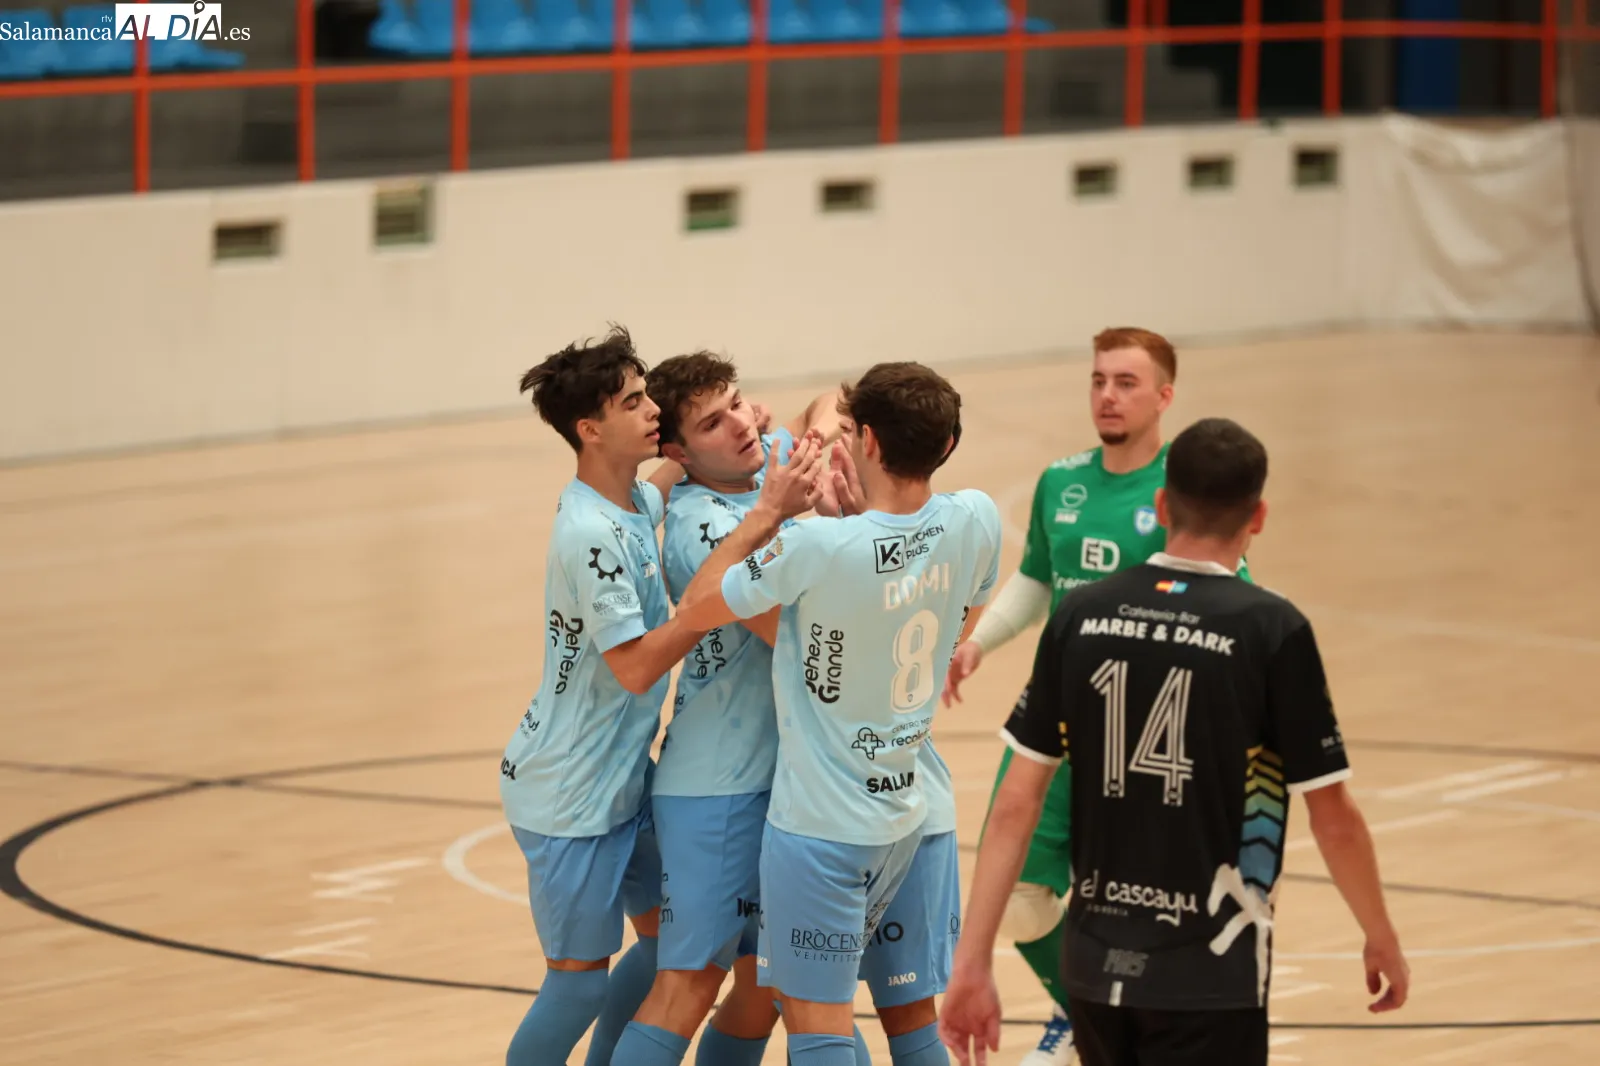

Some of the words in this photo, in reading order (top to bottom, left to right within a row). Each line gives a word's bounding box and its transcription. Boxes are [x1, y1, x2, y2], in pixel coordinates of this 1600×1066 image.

[884, 562, 950, 610] DOMI
[554, 617, 584, 695] Dehesa
[817, 630, 844, 704] Grande
[890, 609, 939, 714] 8
[1079, 617, 1149, 640] MARBE
[1152, 623, 1169, 642] &
[1172, 625, 1235, 656] DARK
[1089, 658, 1194, 807] 14
[1080, 868, 1098, 899] el
[1105, 880, 1198, 927] cascayu
[887, 971, 917, 987] JAKO
